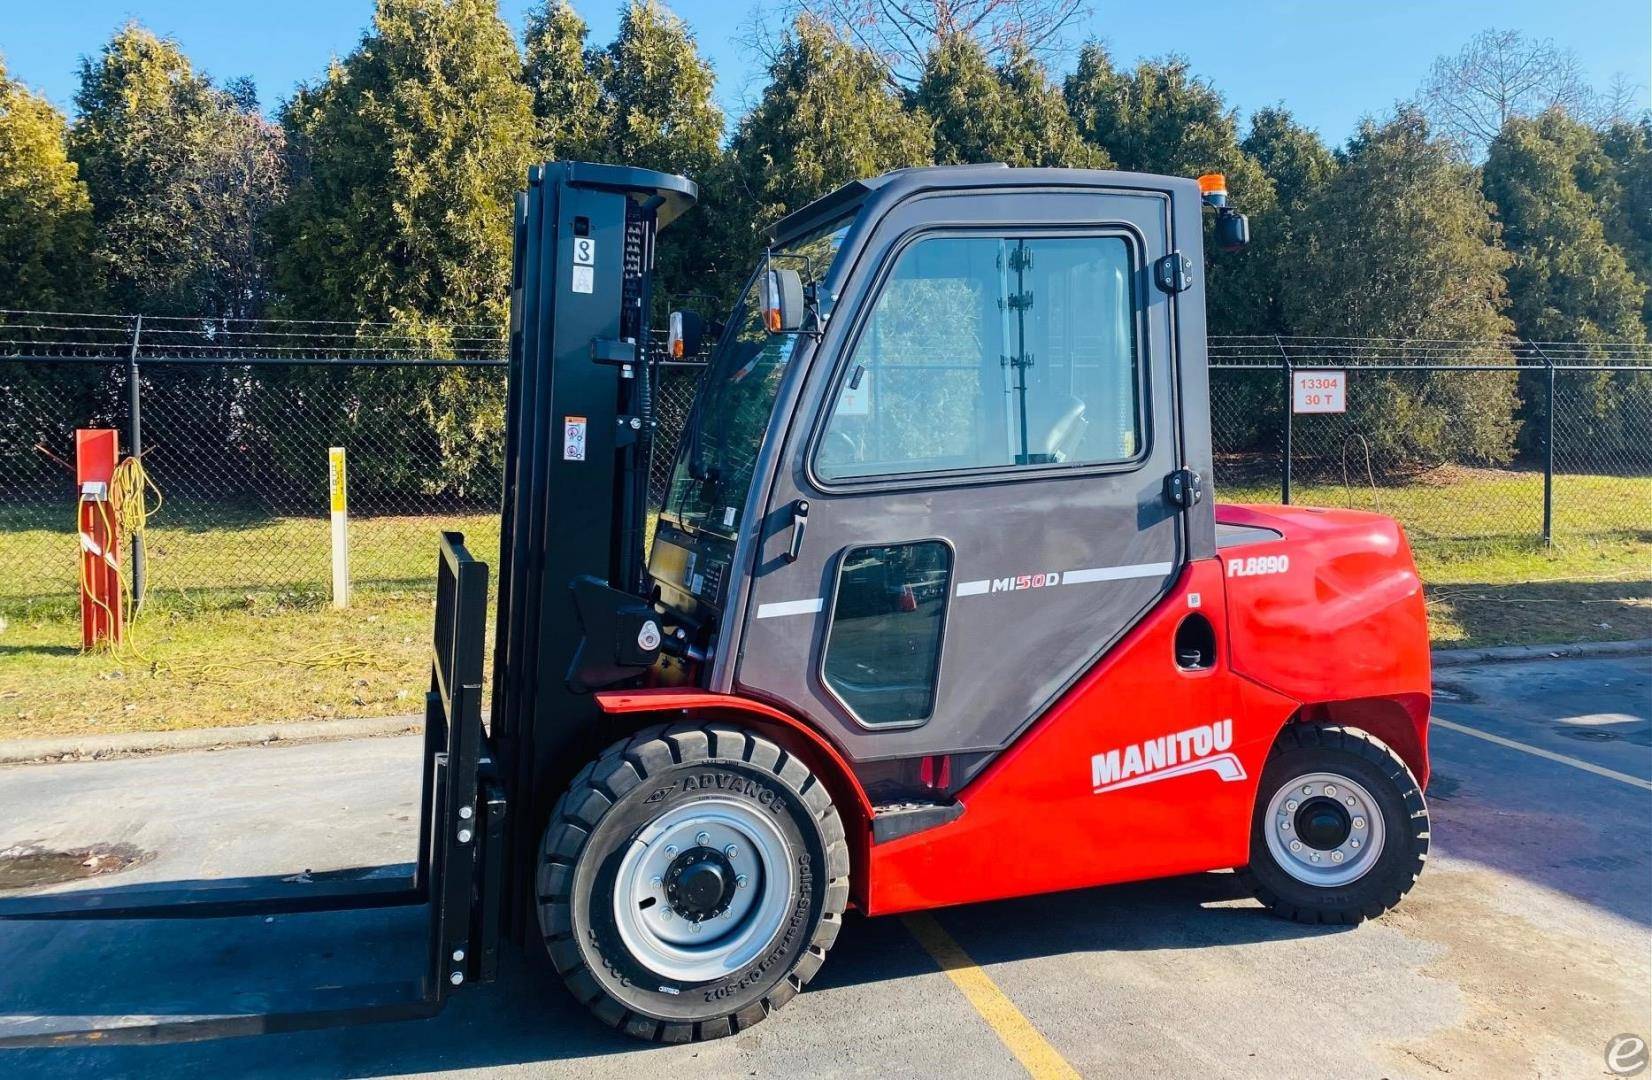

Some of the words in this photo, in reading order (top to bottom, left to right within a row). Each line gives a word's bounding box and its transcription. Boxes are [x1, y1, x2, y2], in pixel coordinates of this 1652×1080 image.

[1300, 378, 1338, 389] 13304
[1305, 394, 1320, 405] 30
[1324, 394, 1333, 405] T
[1227, 555, 1289, 577] FL8890
[991, 572, 1060, 593] MI50D
[1091, 718, 1233, 787] MANITOU
[682, 773, 787, 815] ADVANCE
